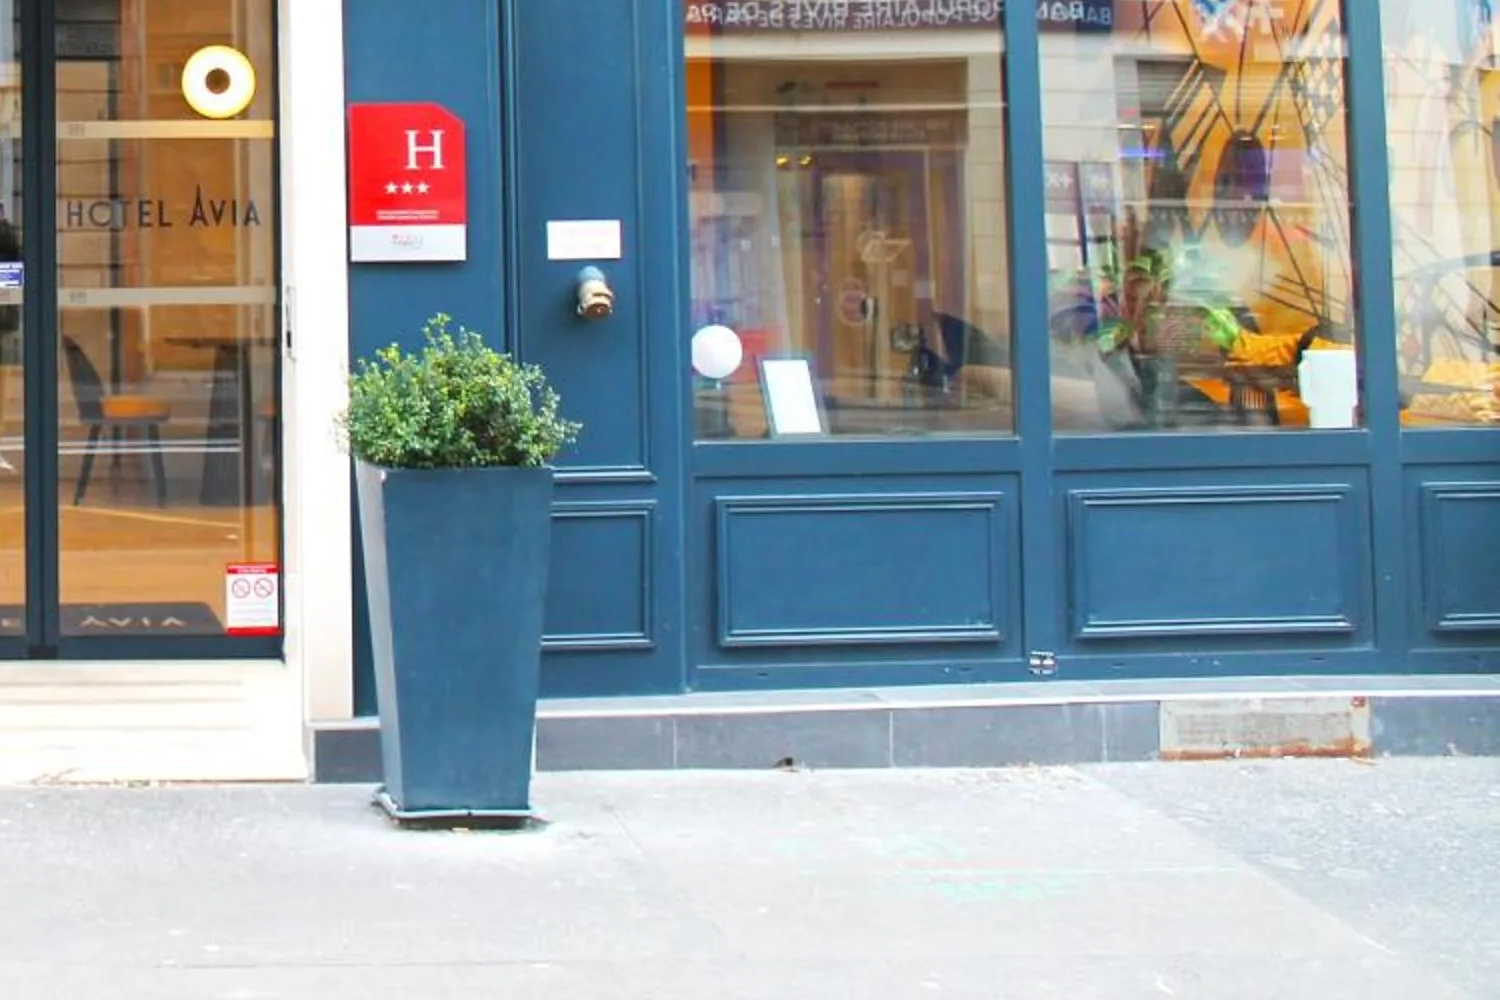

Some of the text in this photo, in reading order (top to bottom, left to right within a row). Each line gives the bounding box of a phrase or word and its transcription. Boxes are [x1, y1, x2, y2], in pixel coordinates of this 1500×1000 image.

[404, 129, 446, 171] H
[67, 184, 261, 228] HOTEL AVIA
